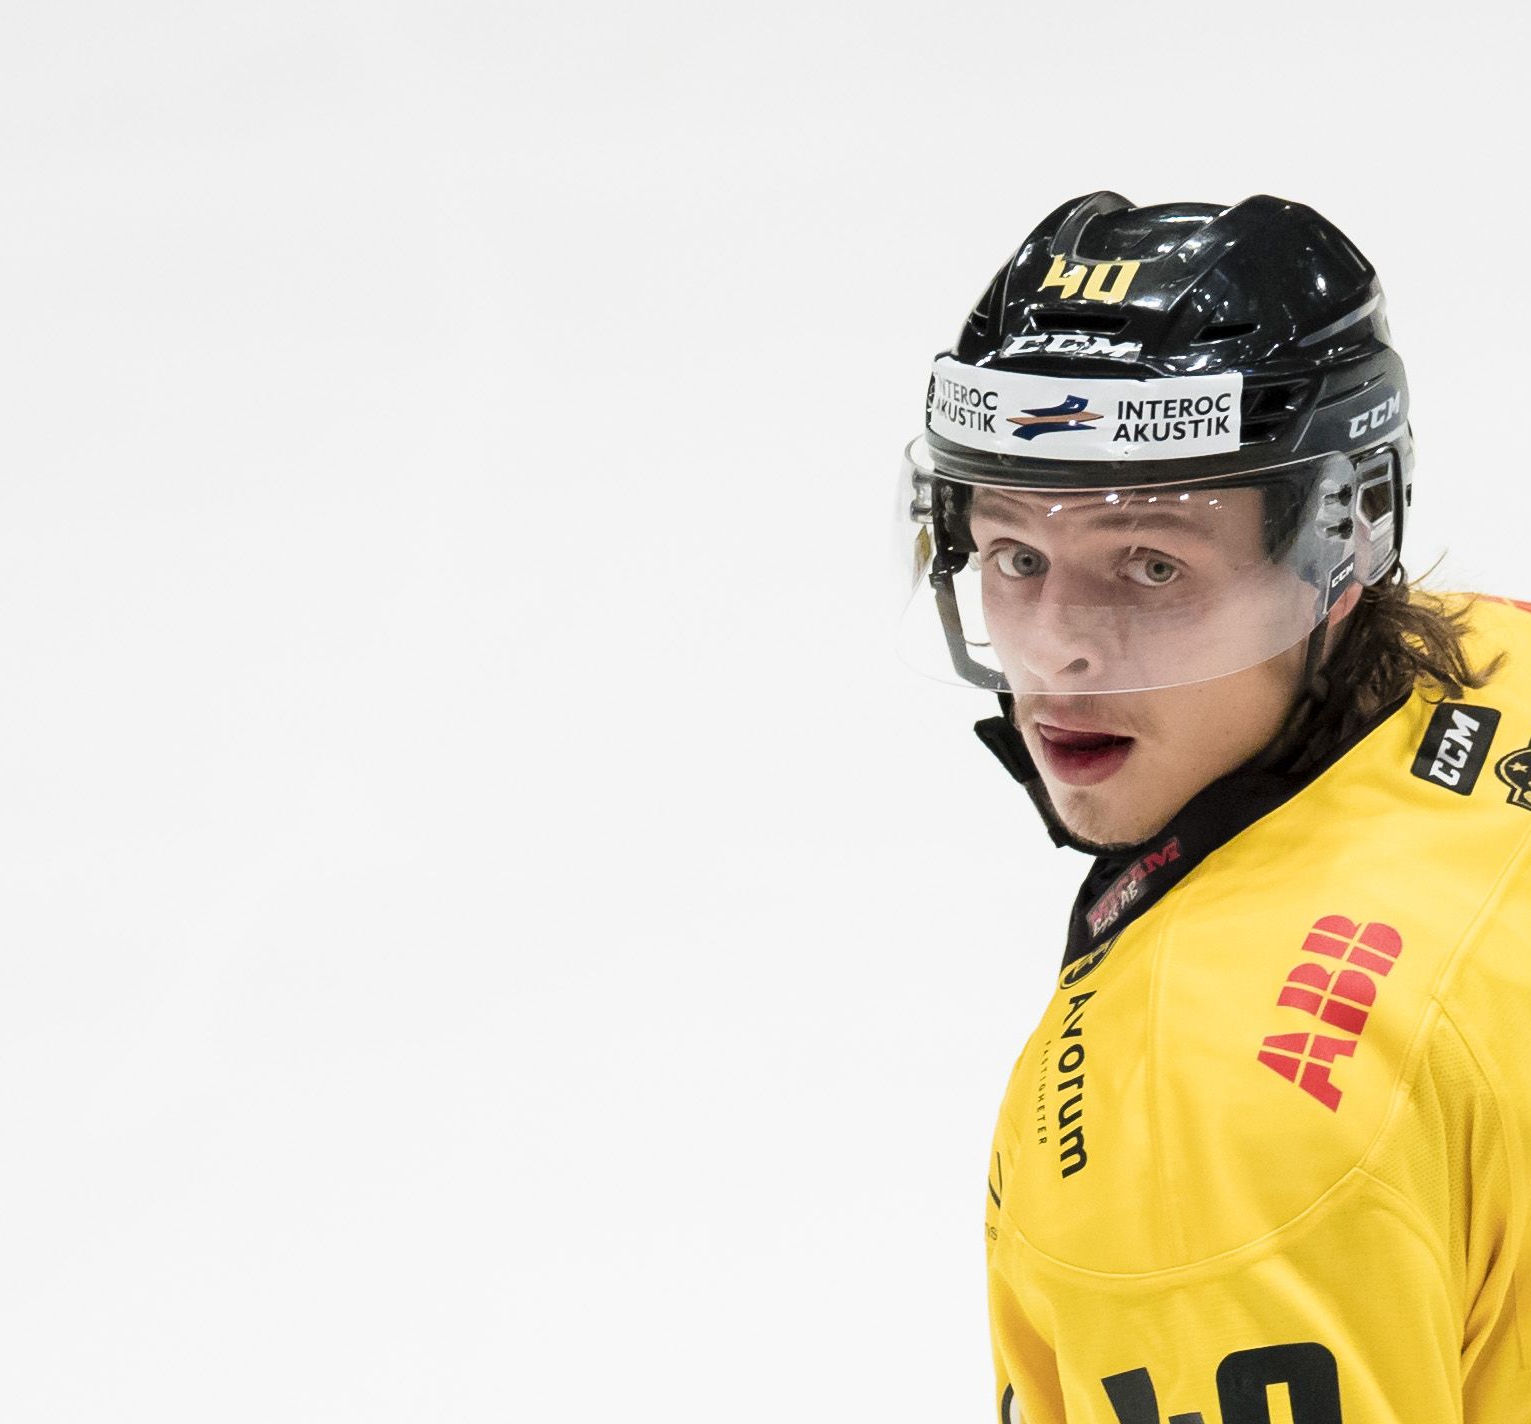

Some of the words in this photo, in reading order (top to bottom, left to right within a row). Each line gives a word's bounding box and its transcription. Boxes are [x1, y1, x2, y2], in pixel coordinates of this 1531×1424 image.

[1042, 253, 1141, 304] 40
[1005, 334, 1143, 358] CCM
[1112, 415, 1231, 442] AKUSTIK
[1117, 392, 1232, 420] INTEROC
[1349, 391, 1401, 439] CCM
[1331, 562, 1354, 588] CCM
[1428, 708, 1481, 787] CCM
[1256, 913, 1404, 1114] ABB
[1057, 990, 1098, 1180] Avorum
